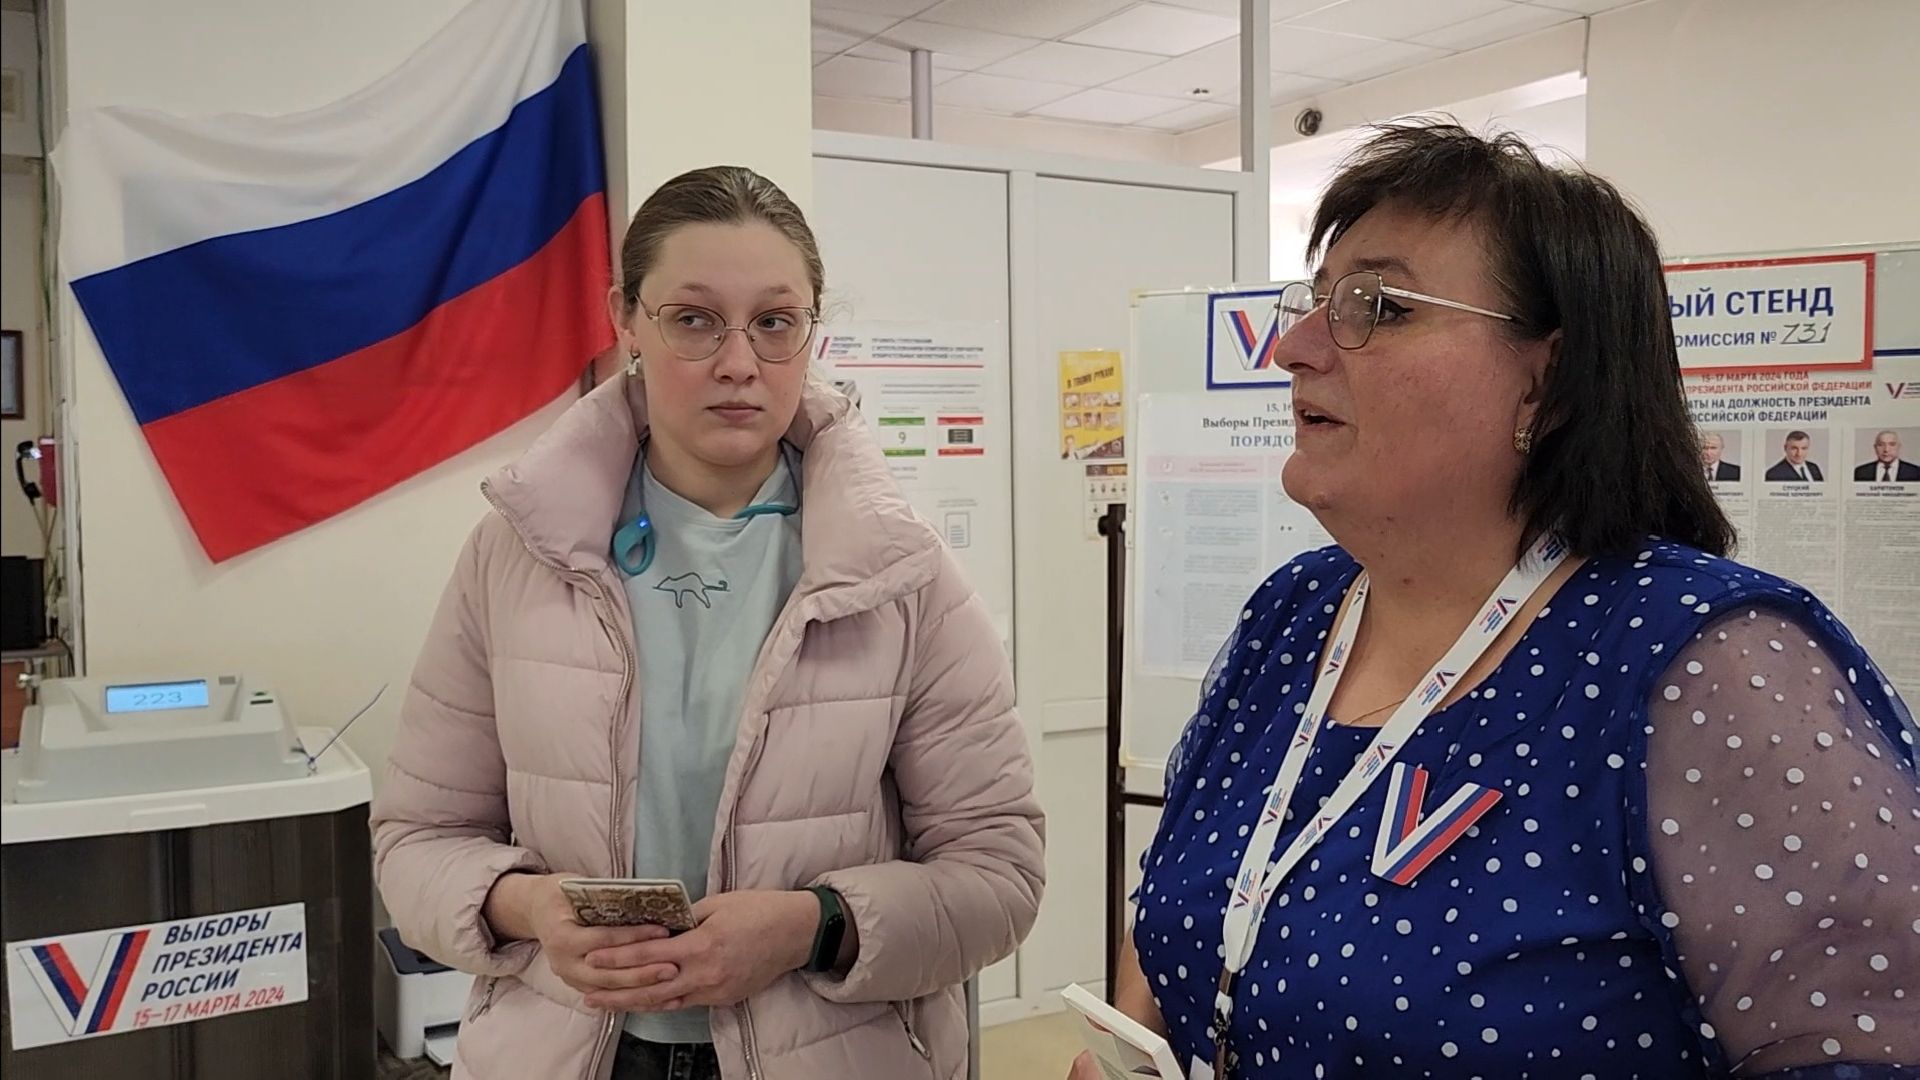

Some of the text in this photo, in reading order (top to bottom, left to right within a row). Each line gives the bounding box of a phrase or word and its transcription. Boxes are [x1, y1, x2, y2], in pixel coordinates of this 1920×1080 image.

[1668, 286, 1834, 318] ЫЙ СТЕНД
[1673, 331, 1756, 348] ОМИССИЯ
[1746, 381, 1810, 393] РОССИЙСКОЙ
[1811, 380, 1873, 392] ФЕДЕРАЦИИ
[1688, 395, 1872, 410] АТЫ НА ДОЛЖНОСТЬ ПРЕЗИДЕНТА
[1202, 417, 1249, 431] Выборы
[1688, 410, 1828, 423] ОССИЙСКОЙ ФЕДЕРАЦИИ
[1230, 435, 1295, 448] ПОРЯДО
[133, 691, 183, 707] 223
[163, 911, 272, 946] ВЫБОРЫ
[152, 931, 303, 974] ПРЕЗИДЕНТА
[140, 968, 241, 1002] РОССИИ
[183, 992, 241, 1019] МАРТА
[244, 985, 285, 1008] 2024
